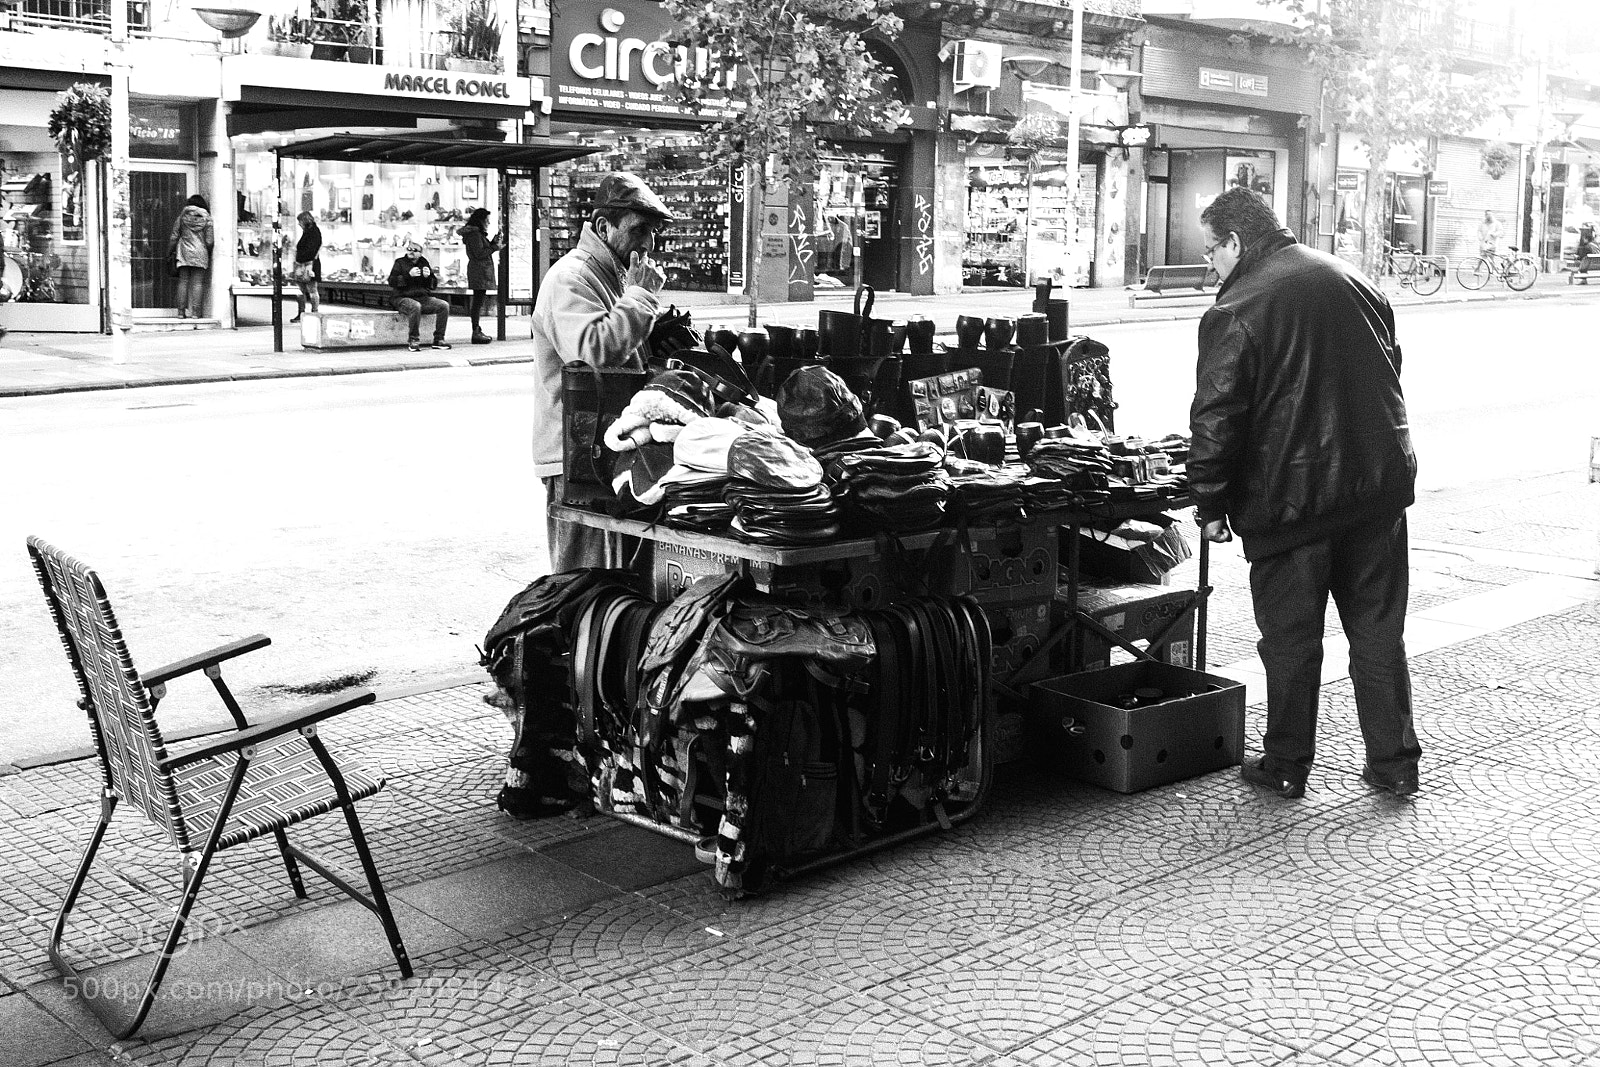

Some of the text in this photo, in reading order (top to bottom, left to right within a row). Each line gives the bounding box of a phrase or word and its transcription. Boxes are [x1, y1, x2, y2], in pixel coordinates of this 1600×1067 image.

[384, 73, 510, 98] MARCEL RONEL
[659, 541, 707, 560] BANANAS
